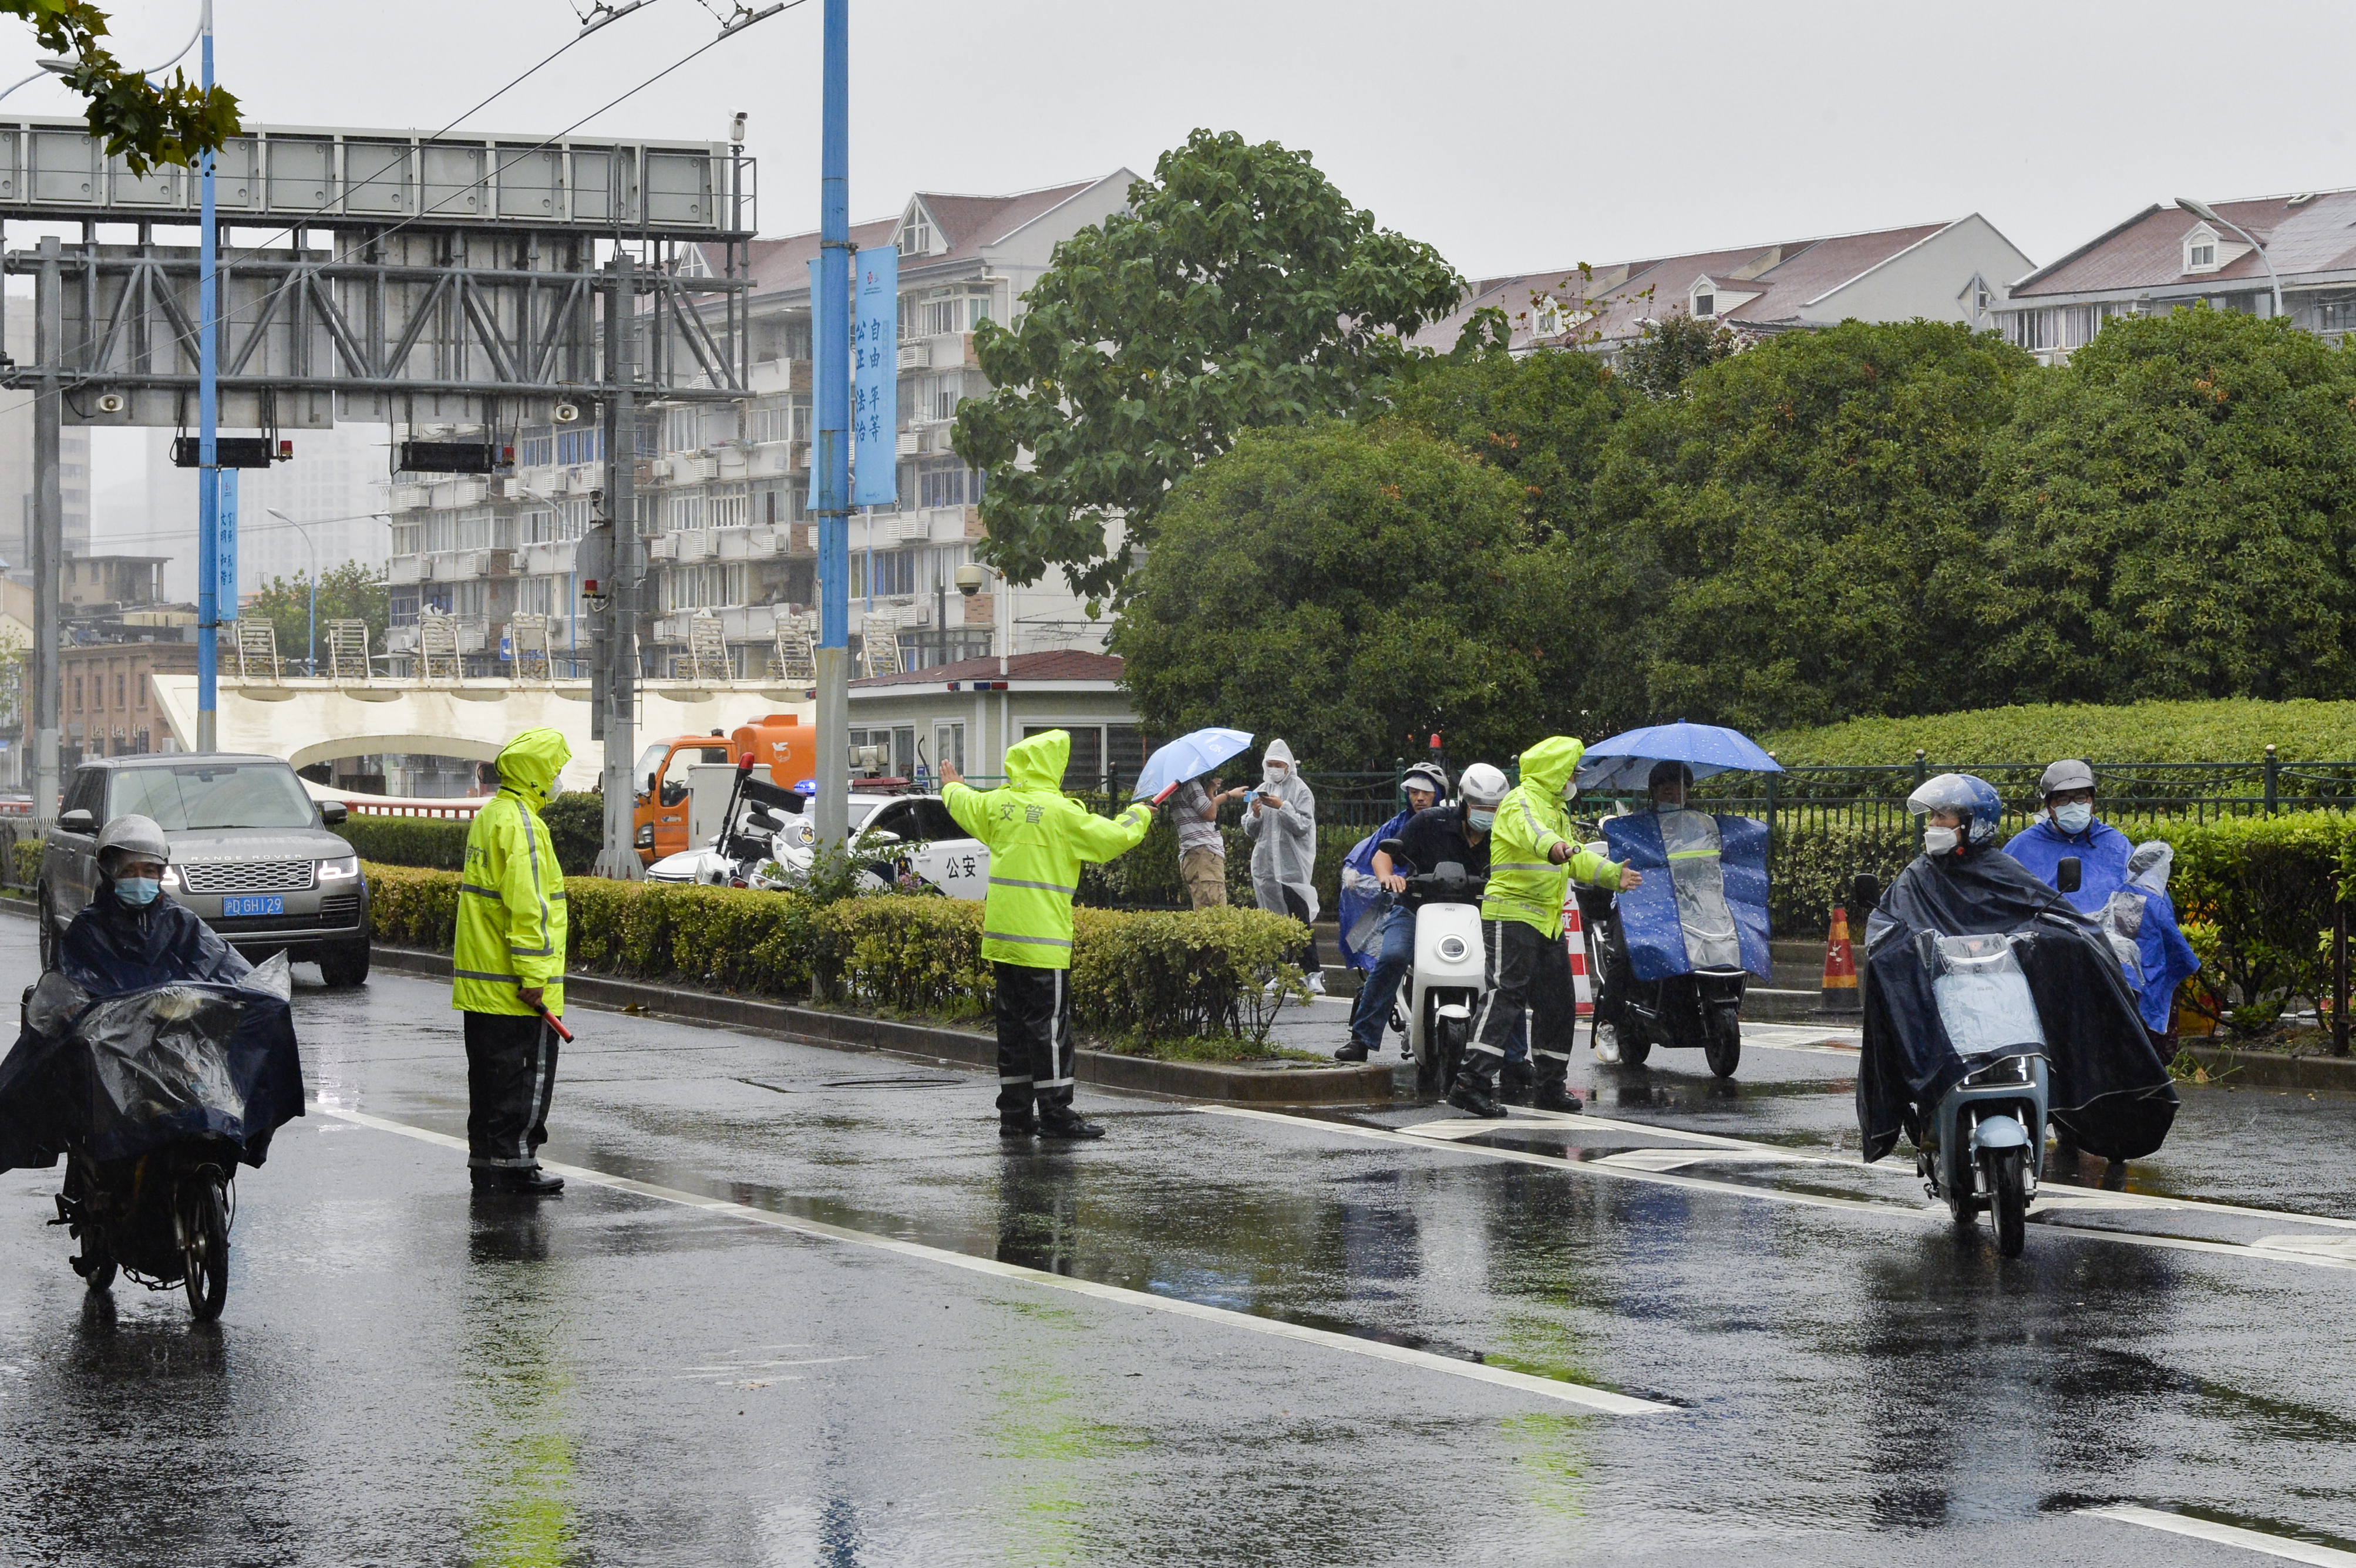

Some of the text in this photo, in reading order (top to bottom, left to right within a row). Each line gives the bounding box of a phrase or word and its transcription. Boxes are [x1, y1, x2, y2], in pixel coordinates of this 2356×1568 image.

[856, 320, 866, 443] 公正 法治
[869, 318, 881, 443] 自由 平等
[1000, 802, 1045, 825] 交管
[946, 854, 976, 879] 公安
